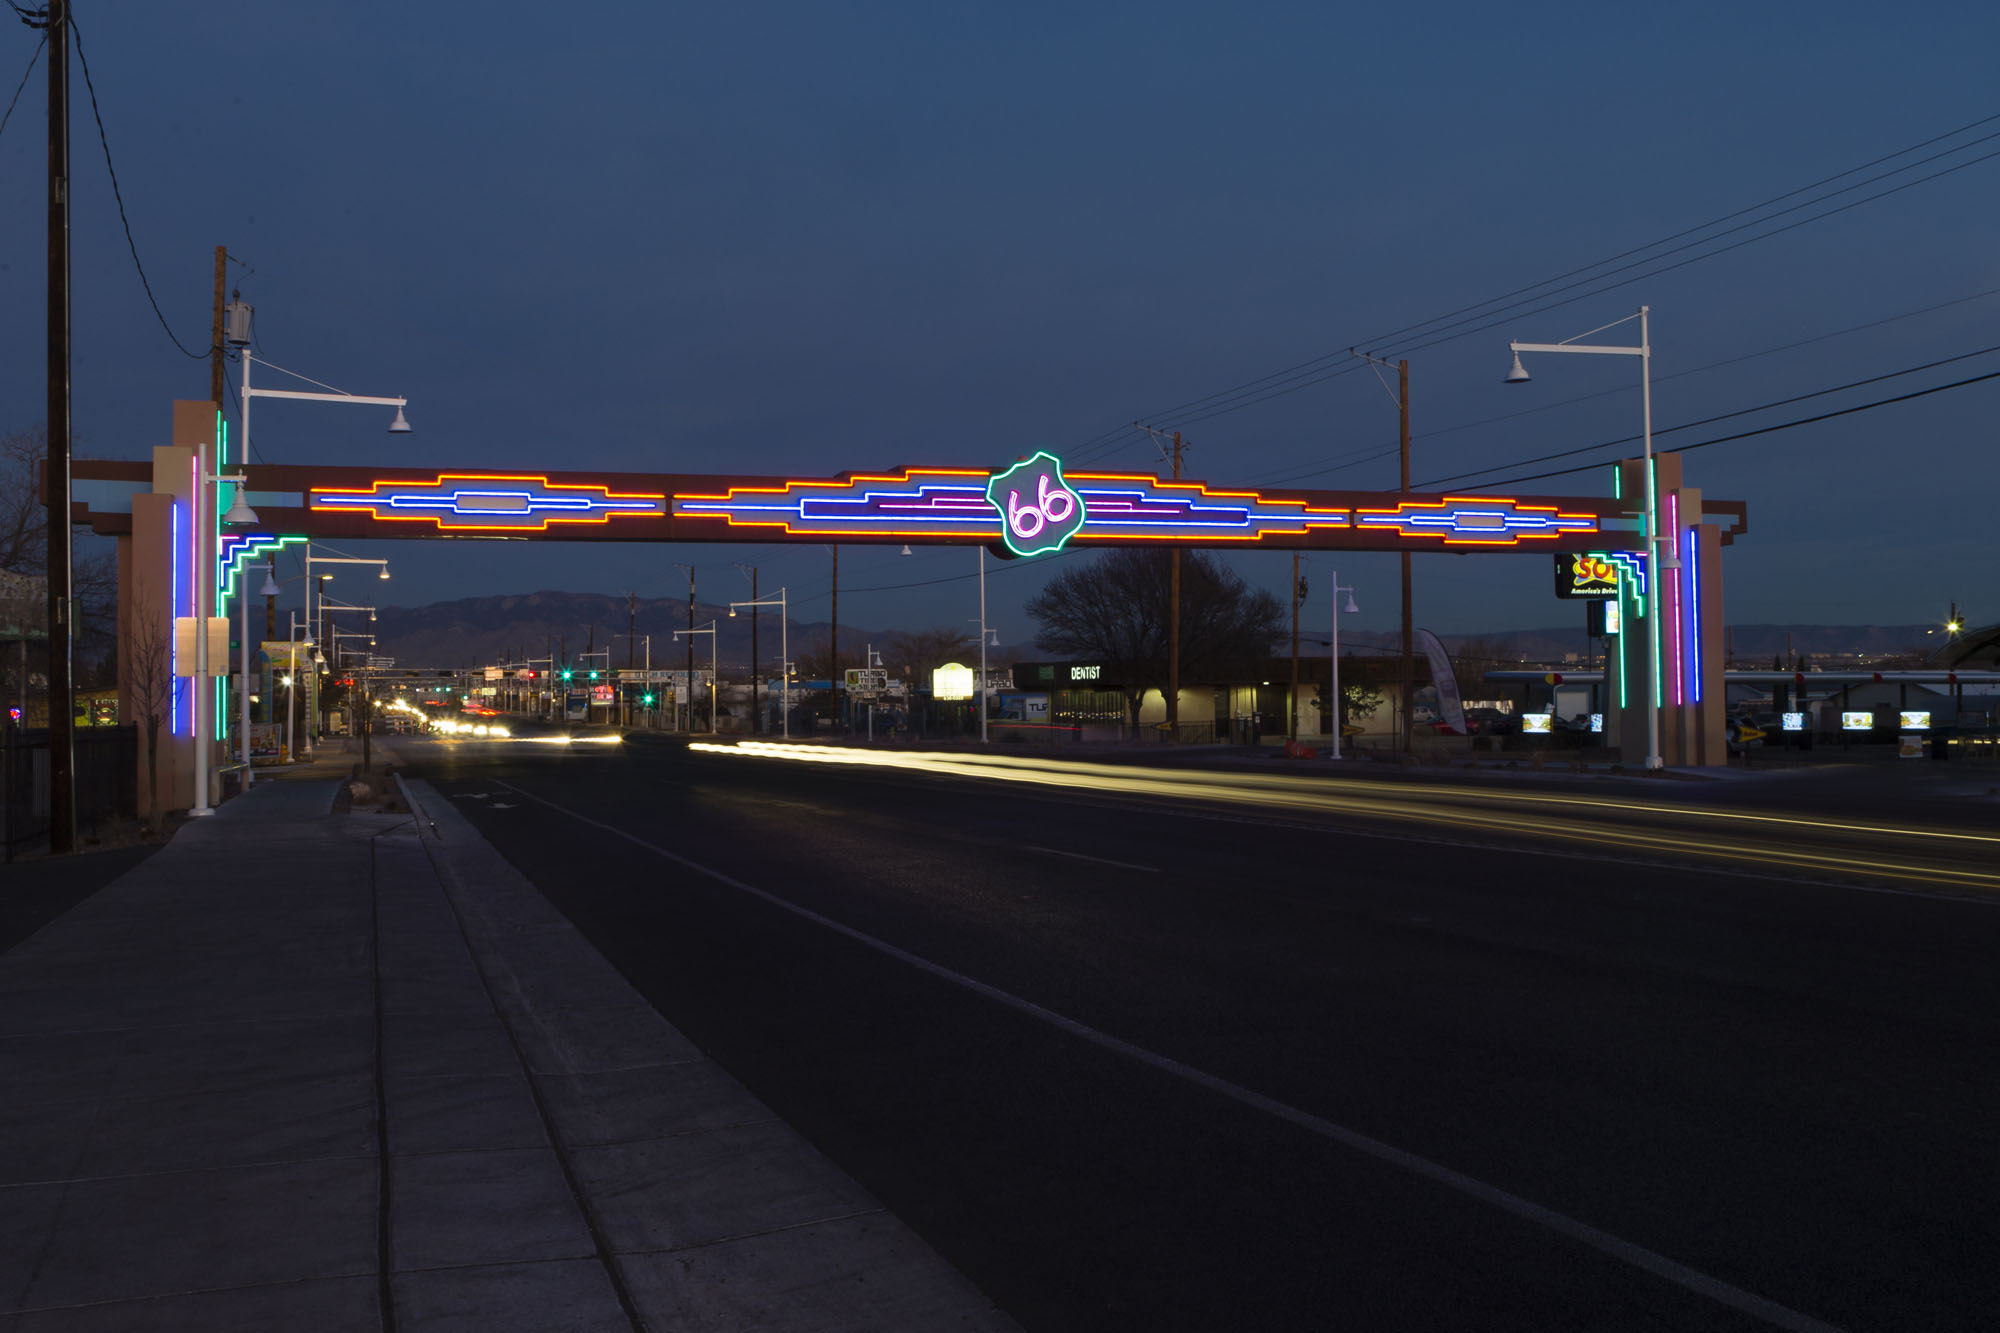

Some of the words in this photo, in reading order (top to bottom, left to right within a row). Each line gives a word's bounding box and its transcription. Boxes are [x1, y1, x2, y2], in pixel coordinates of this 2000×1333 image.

[1008, 474, 1075, 539] 66
[1570, 587, 1601, 595] America's
[1071, 666, 1101, 680] DENTIST
[985, 680, 1012, 688] URBO
